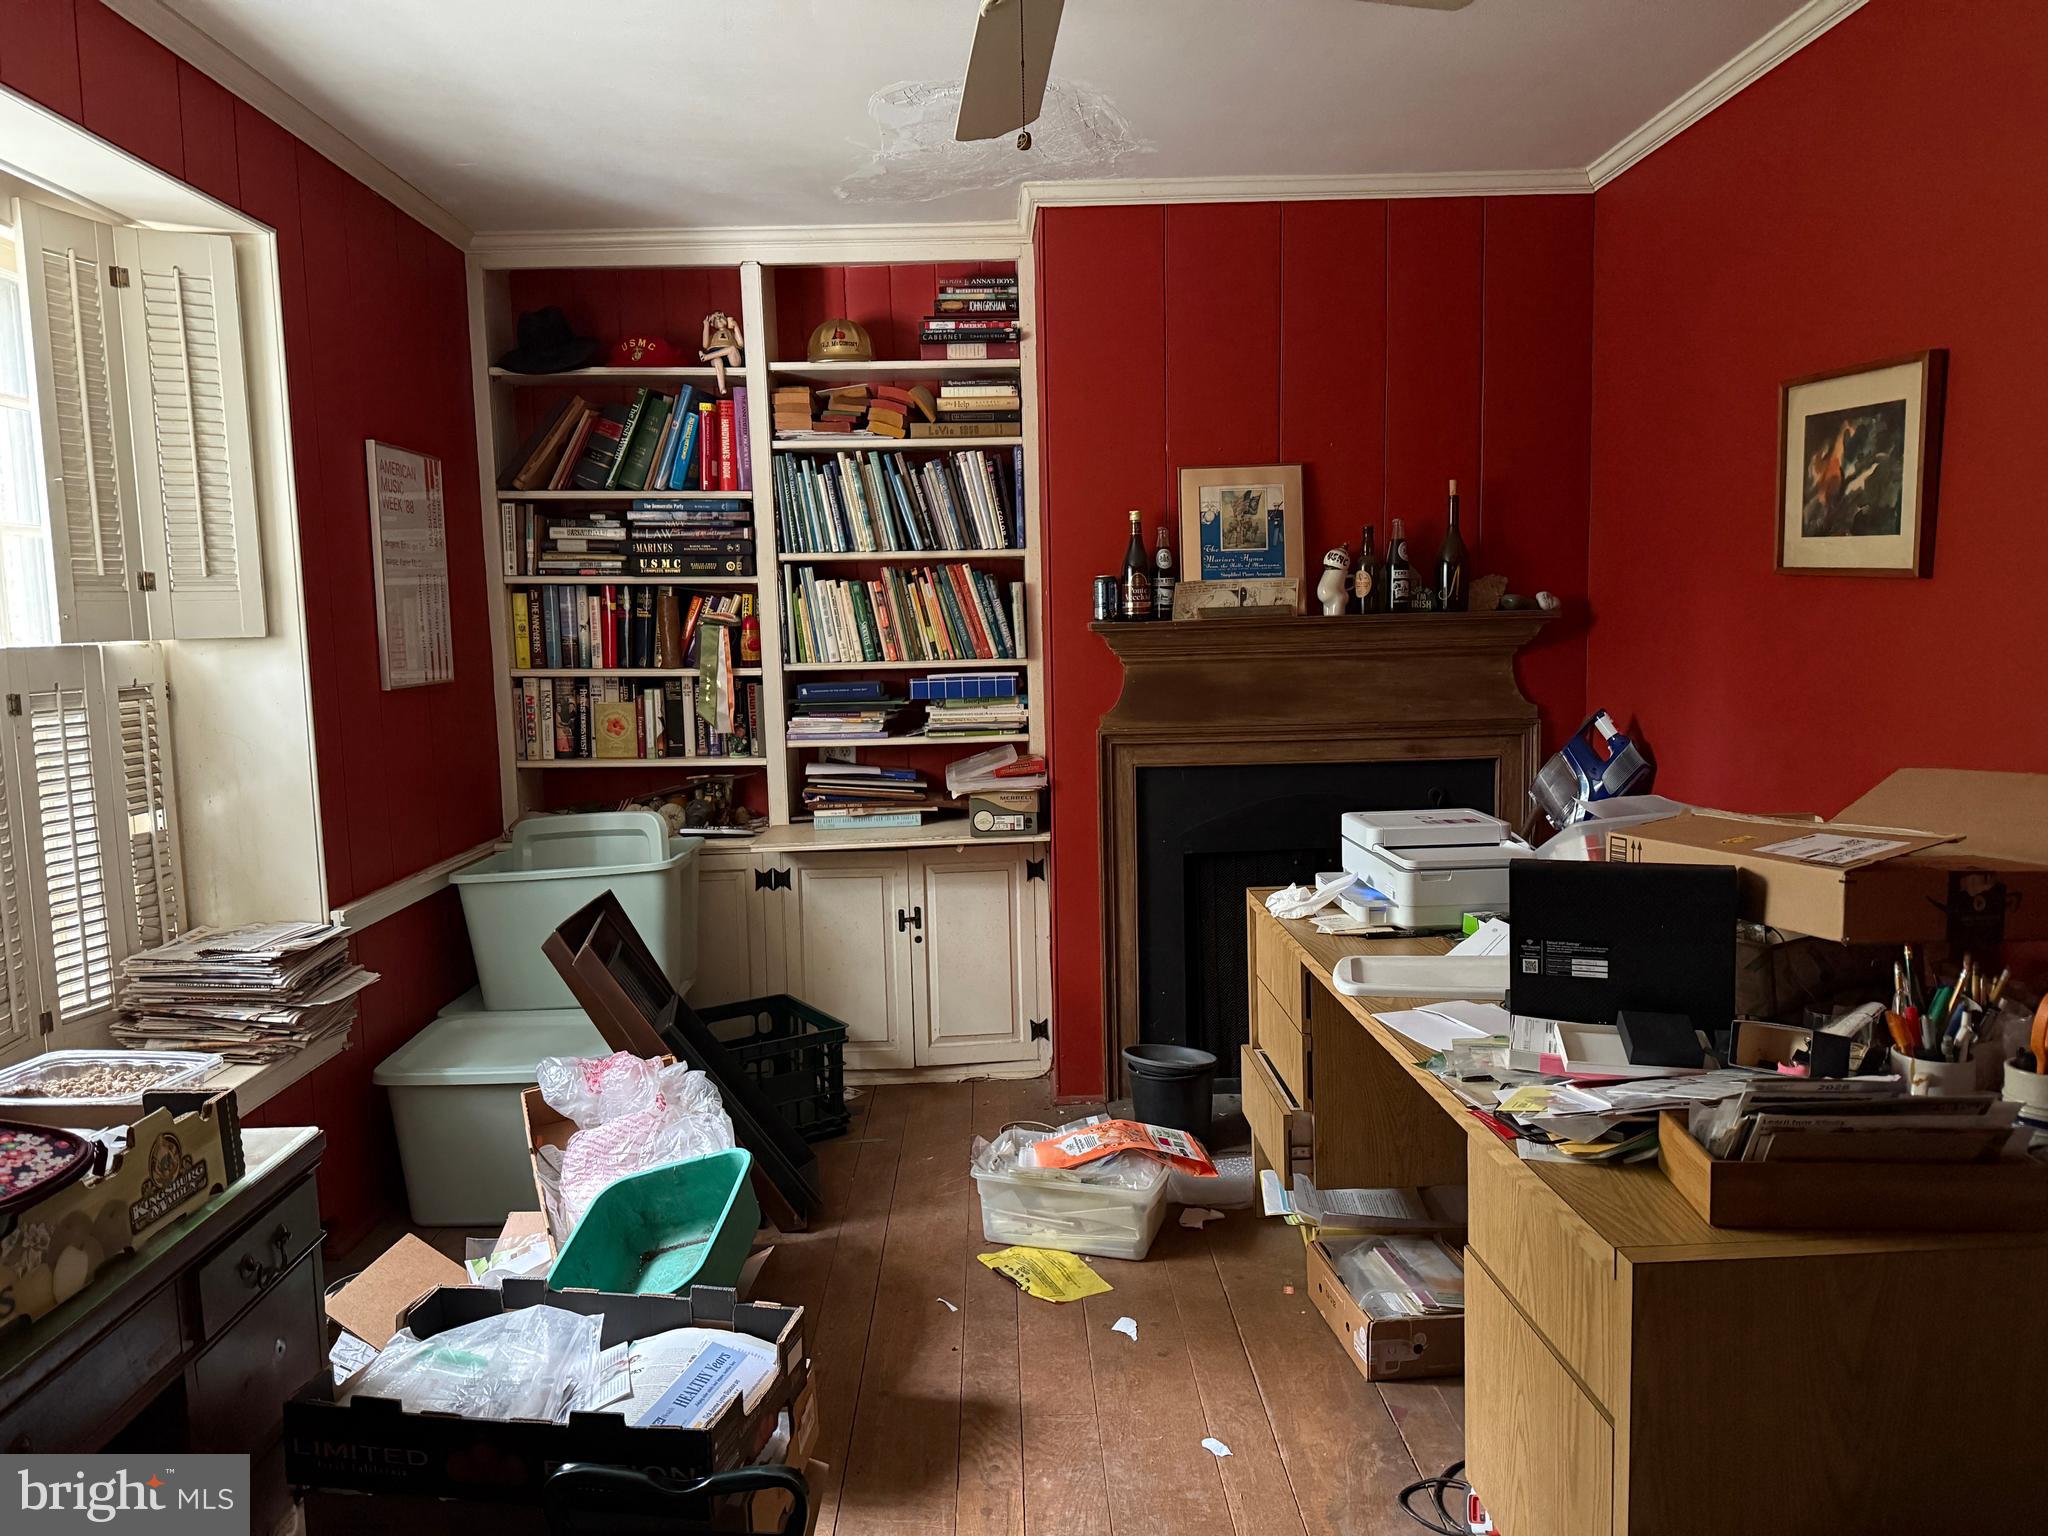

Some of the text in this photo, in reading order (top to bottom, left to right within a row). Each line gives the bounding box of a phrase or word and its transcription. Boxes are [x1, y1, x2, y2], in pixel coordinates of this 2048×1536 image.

[968, 300, 1006, 311] JOHN GRISHAM
[621, 338, 656, 351] USMC
[628, 403, 640, 418] The
[954, 401, 970, 409] Help
[379, 458, 417, 481] AMERICAN
[722, 461, 731, 479] BOOK
[380, 476, 405, 495] MUSIC
[381, 496, 403, 512] WEEK
[997, 510, 1007, 536] COLOR
[645, 529, 673, 539] LAW
[636, 543, 673, 553] MARINES
[1203, 544, 1219, 552] The
[1326, 551, 1349, 567] USMC
[1411, 600, 1432, 609] IRISH
[525, 695, 536, 744] MERGER
[132, 1166, 204, 1220] KINGSBURG
[673, 1352, 731, 1408] HEALTHY Years
[293, 1436, 429, 1467] LIMITED
